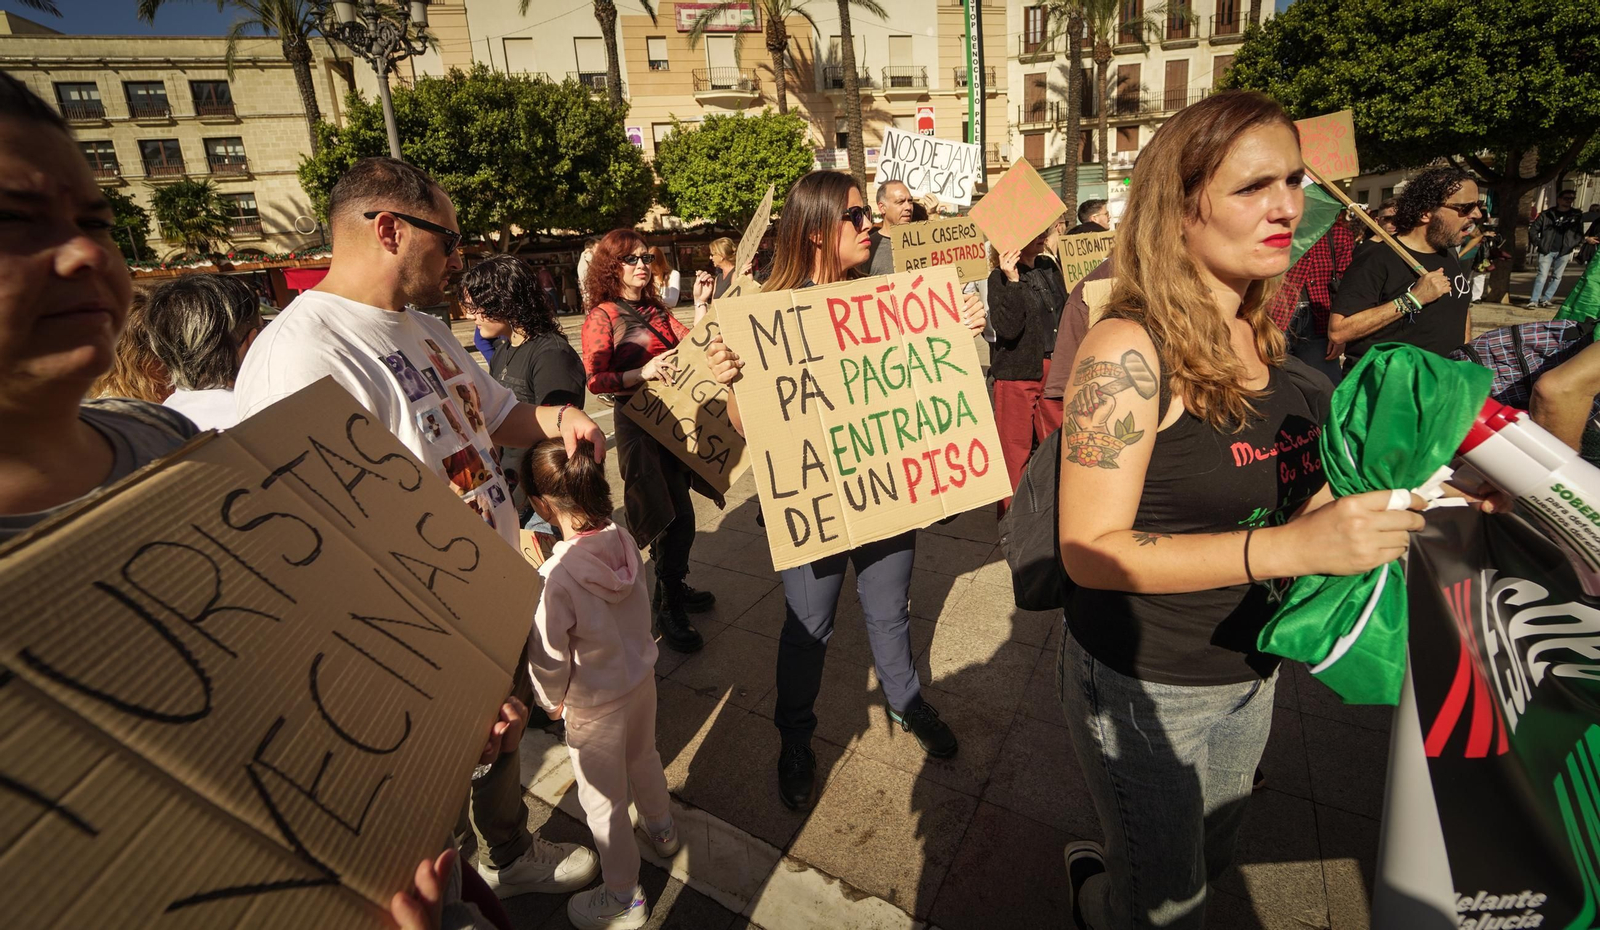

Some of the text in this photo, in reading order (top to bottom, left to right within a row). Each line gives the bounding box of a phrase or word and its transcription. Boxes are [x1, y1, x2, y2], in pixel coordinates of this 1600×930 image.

[971, 35, 981, 104] GENOCIDIO
[902, 222, 977, 249] ALL CASEROS
[905, 242, 986, 274] ARE BASTARDS
[1061, 239, 1075, 257] TO
[1067, 262, 1084, 283] ERA
[748, 304, 825, 371] MI
[826, 274, 961, 352] RIÑÓN
[775, 336, 969, 422] PA PAGAR
[629, 387, 732, 475] SIN CASA
[765, 390, 979, 500] LA ENTRADA
[1068, 434, 1123, 451] CLASS
[783, 437, 990, 548] DE UN PISO
[1529, 495, 1571, 528] nuestros
[1545, 496, 1570, 515] para
[164, 511, 481, 914] VECINAS
